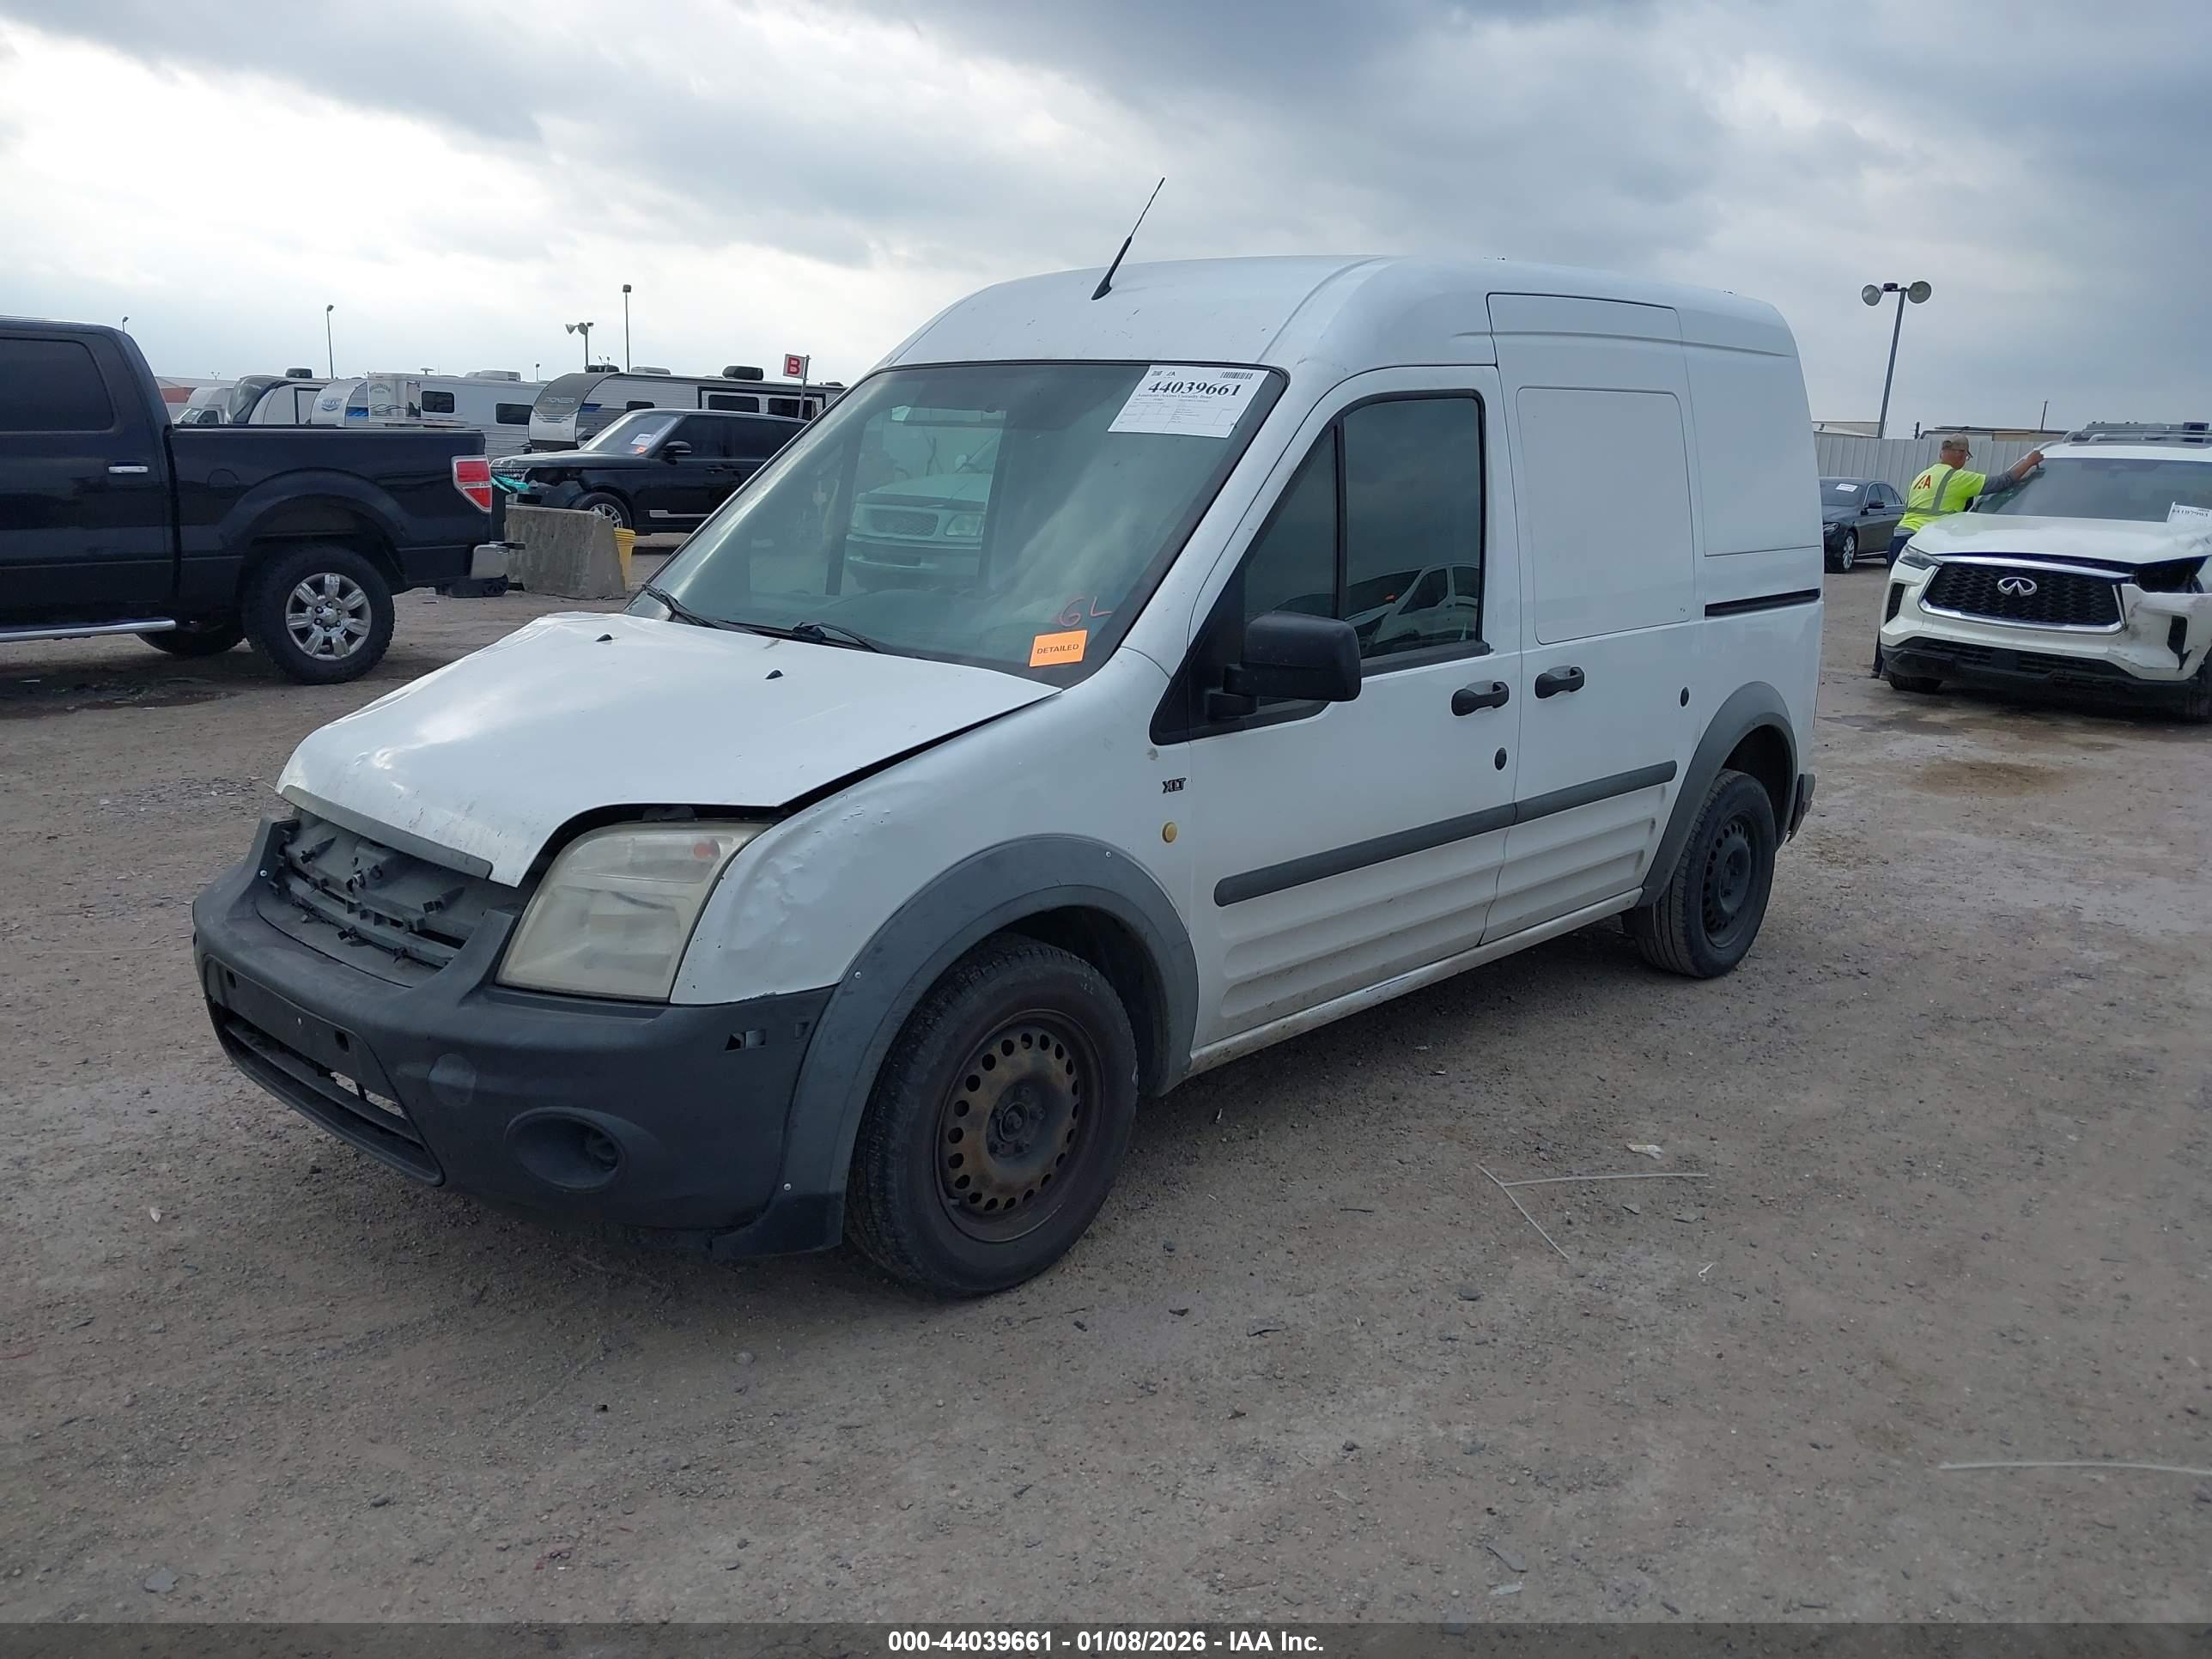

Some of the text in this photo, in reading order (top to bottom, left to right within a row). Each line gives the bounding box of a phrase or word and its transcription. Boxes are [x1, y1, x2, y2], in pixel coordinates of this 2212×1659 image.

[787, 356, 800, 375] B
[1148, 381, 1242, 396] 44039661
[1036, 643, 1079, 654] DETAILED
[1162, 777, 1187, 794] XLT
